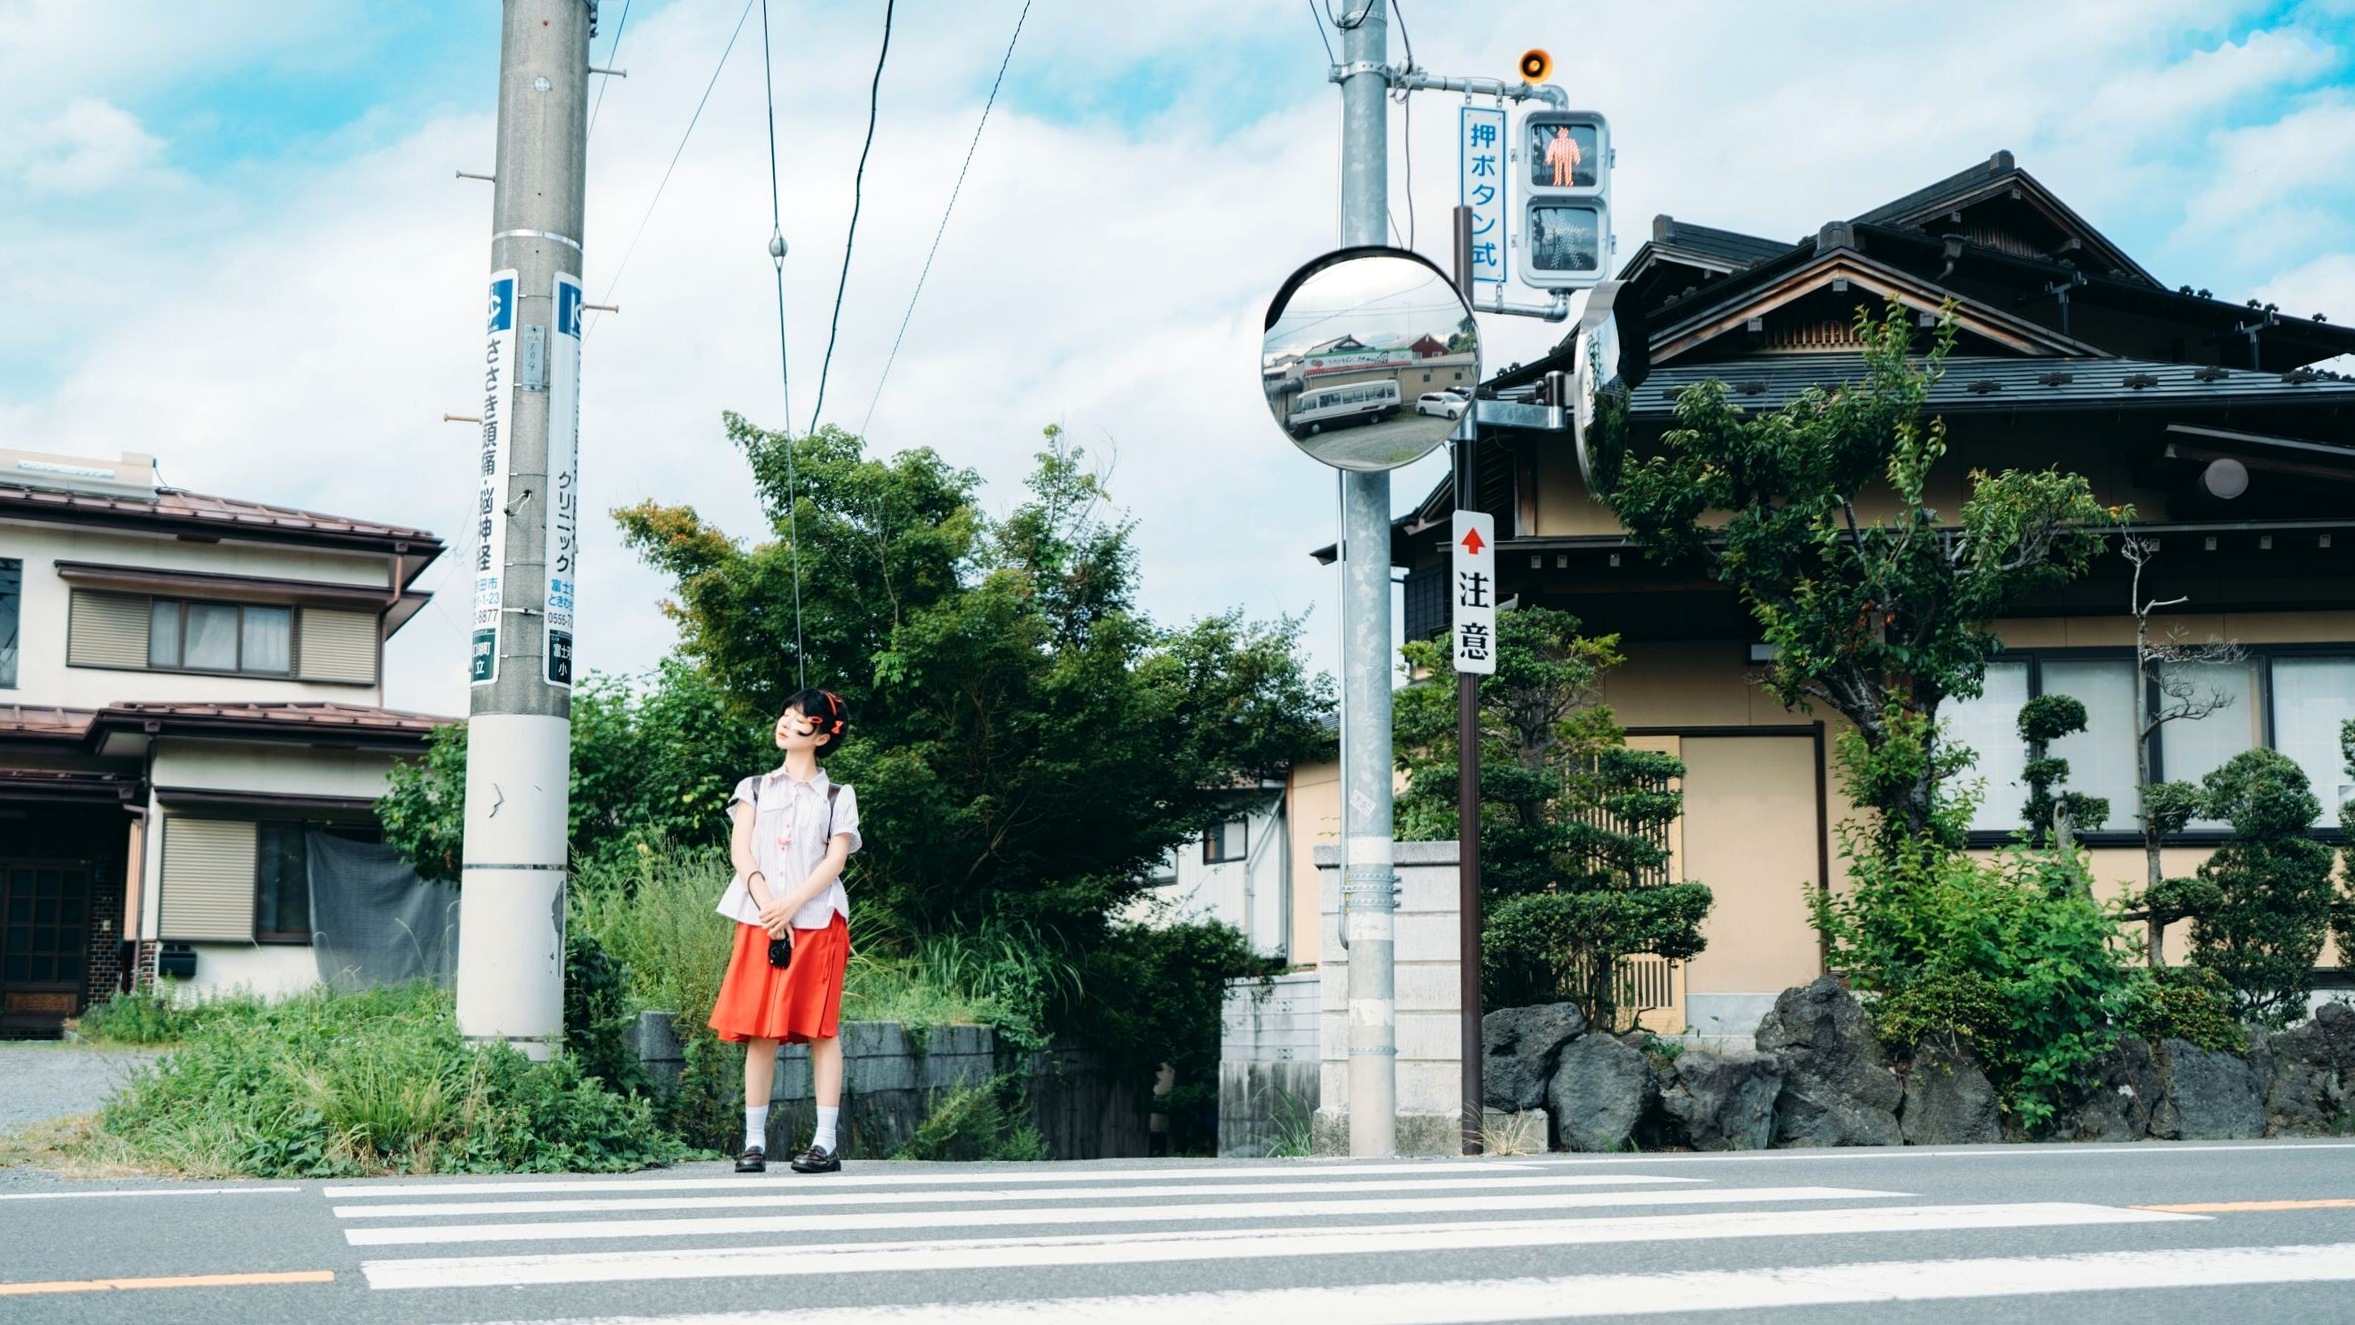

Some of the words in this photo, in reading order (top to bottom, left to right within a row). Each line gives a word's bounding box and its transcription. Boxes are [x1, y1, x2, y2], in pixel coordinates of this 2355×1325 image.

[1471, 123, 1497, 267] 押ボタン式
[556, 471, 572, 573] クリニック
[1459, 571, 1490, 660] 注意
